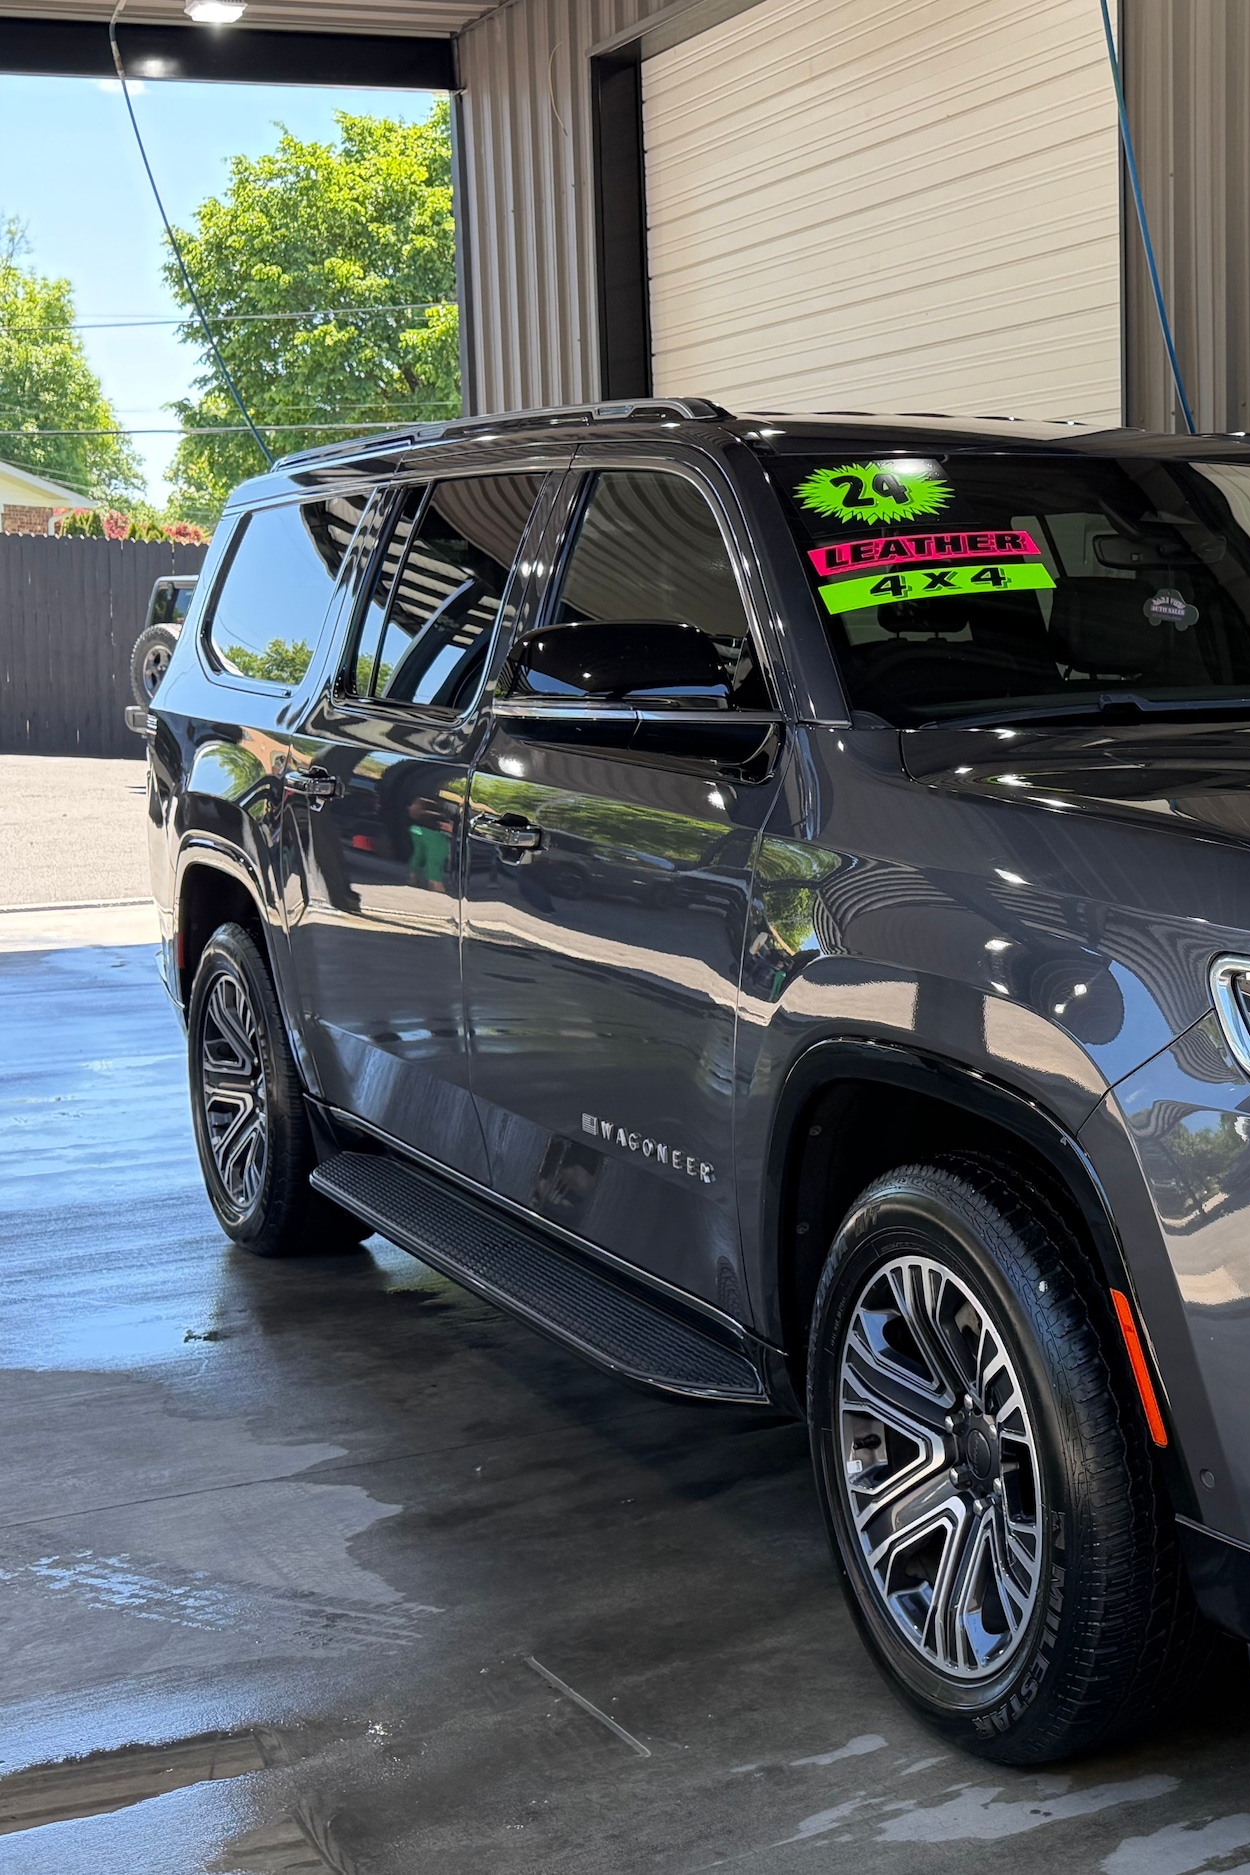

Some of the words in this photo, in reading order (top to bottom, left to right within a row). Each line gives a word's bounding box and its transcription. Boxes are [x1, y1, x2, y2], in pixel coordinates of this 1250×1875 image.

[830, 473, 911, 508] 24
[826, 532, 1026, 569] LEATHER
[601, 1120, 713, 1183] WAGONEER
[971, 1561, 1066, 1740] MILESTAR
